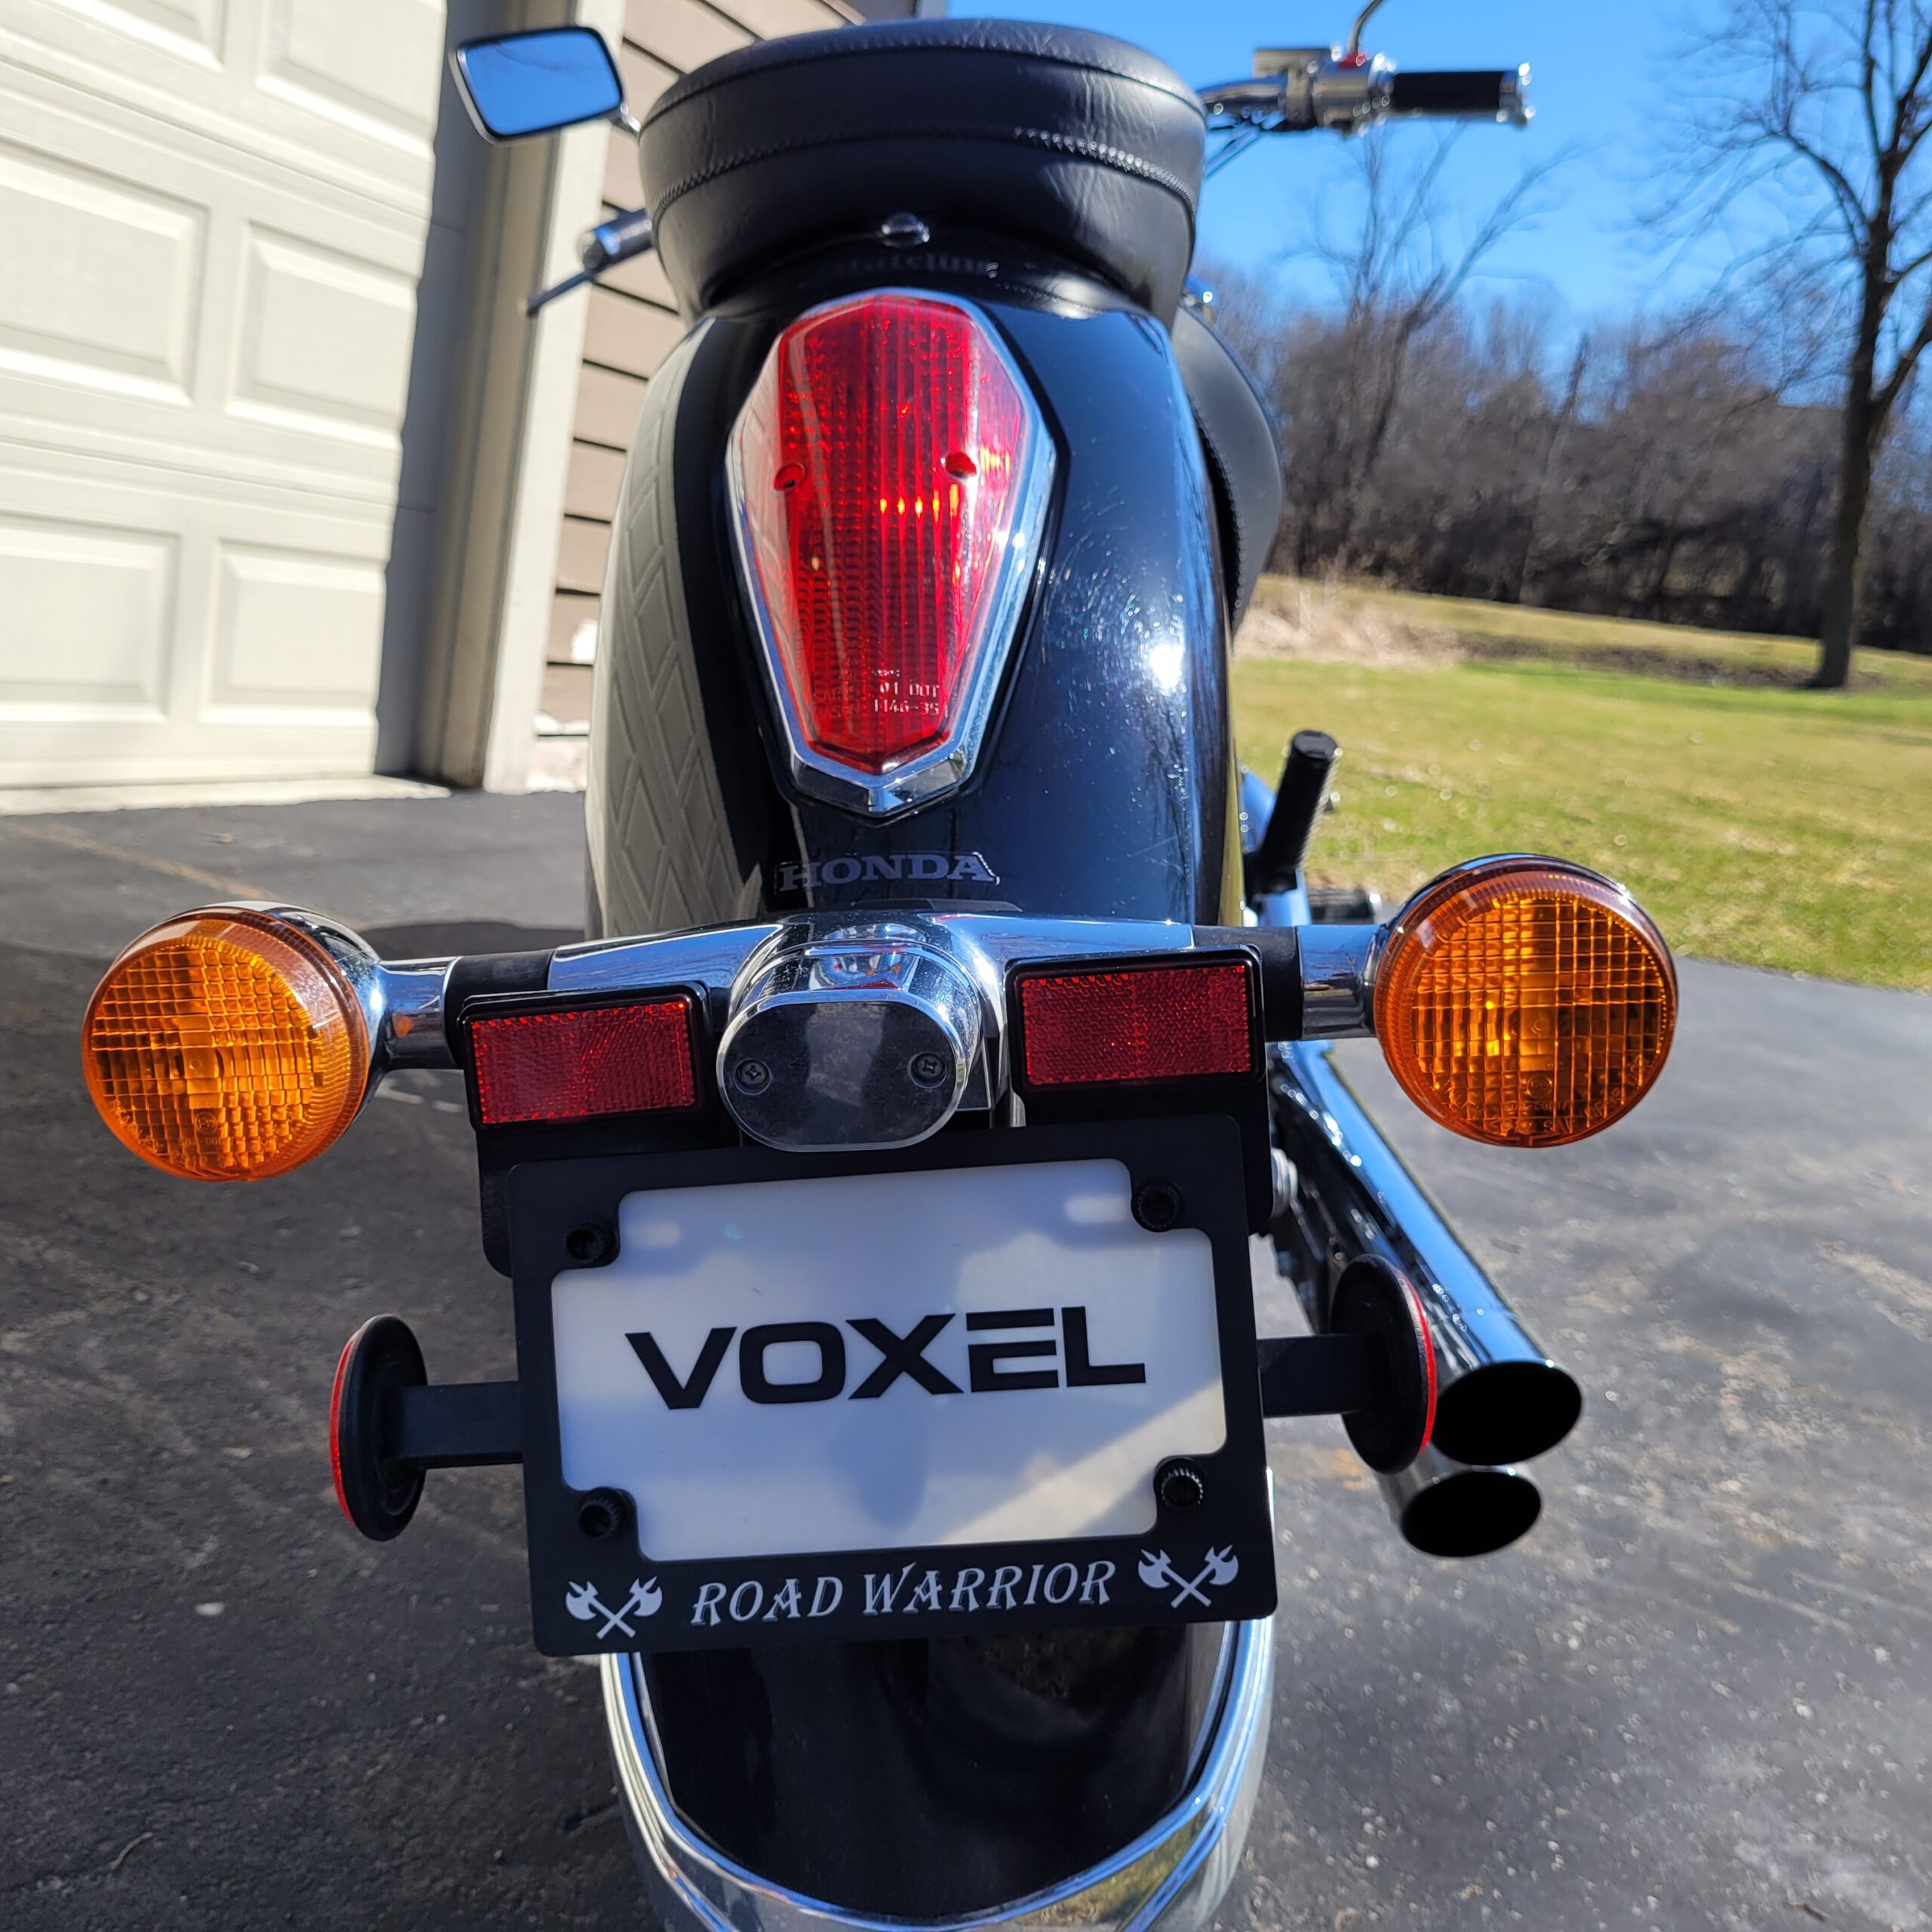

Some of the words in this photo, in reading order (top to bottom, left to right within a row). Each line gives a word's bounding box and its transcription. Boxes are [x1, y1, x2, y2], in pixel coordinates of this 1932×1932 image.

[780, 854, 995, 892] HONDA
[625, 1306, 1146, 1410] VOXEL
[691, 1575, 843, 1628] ROAD
[863, 1561, 1117, 1616] WARRIOR
